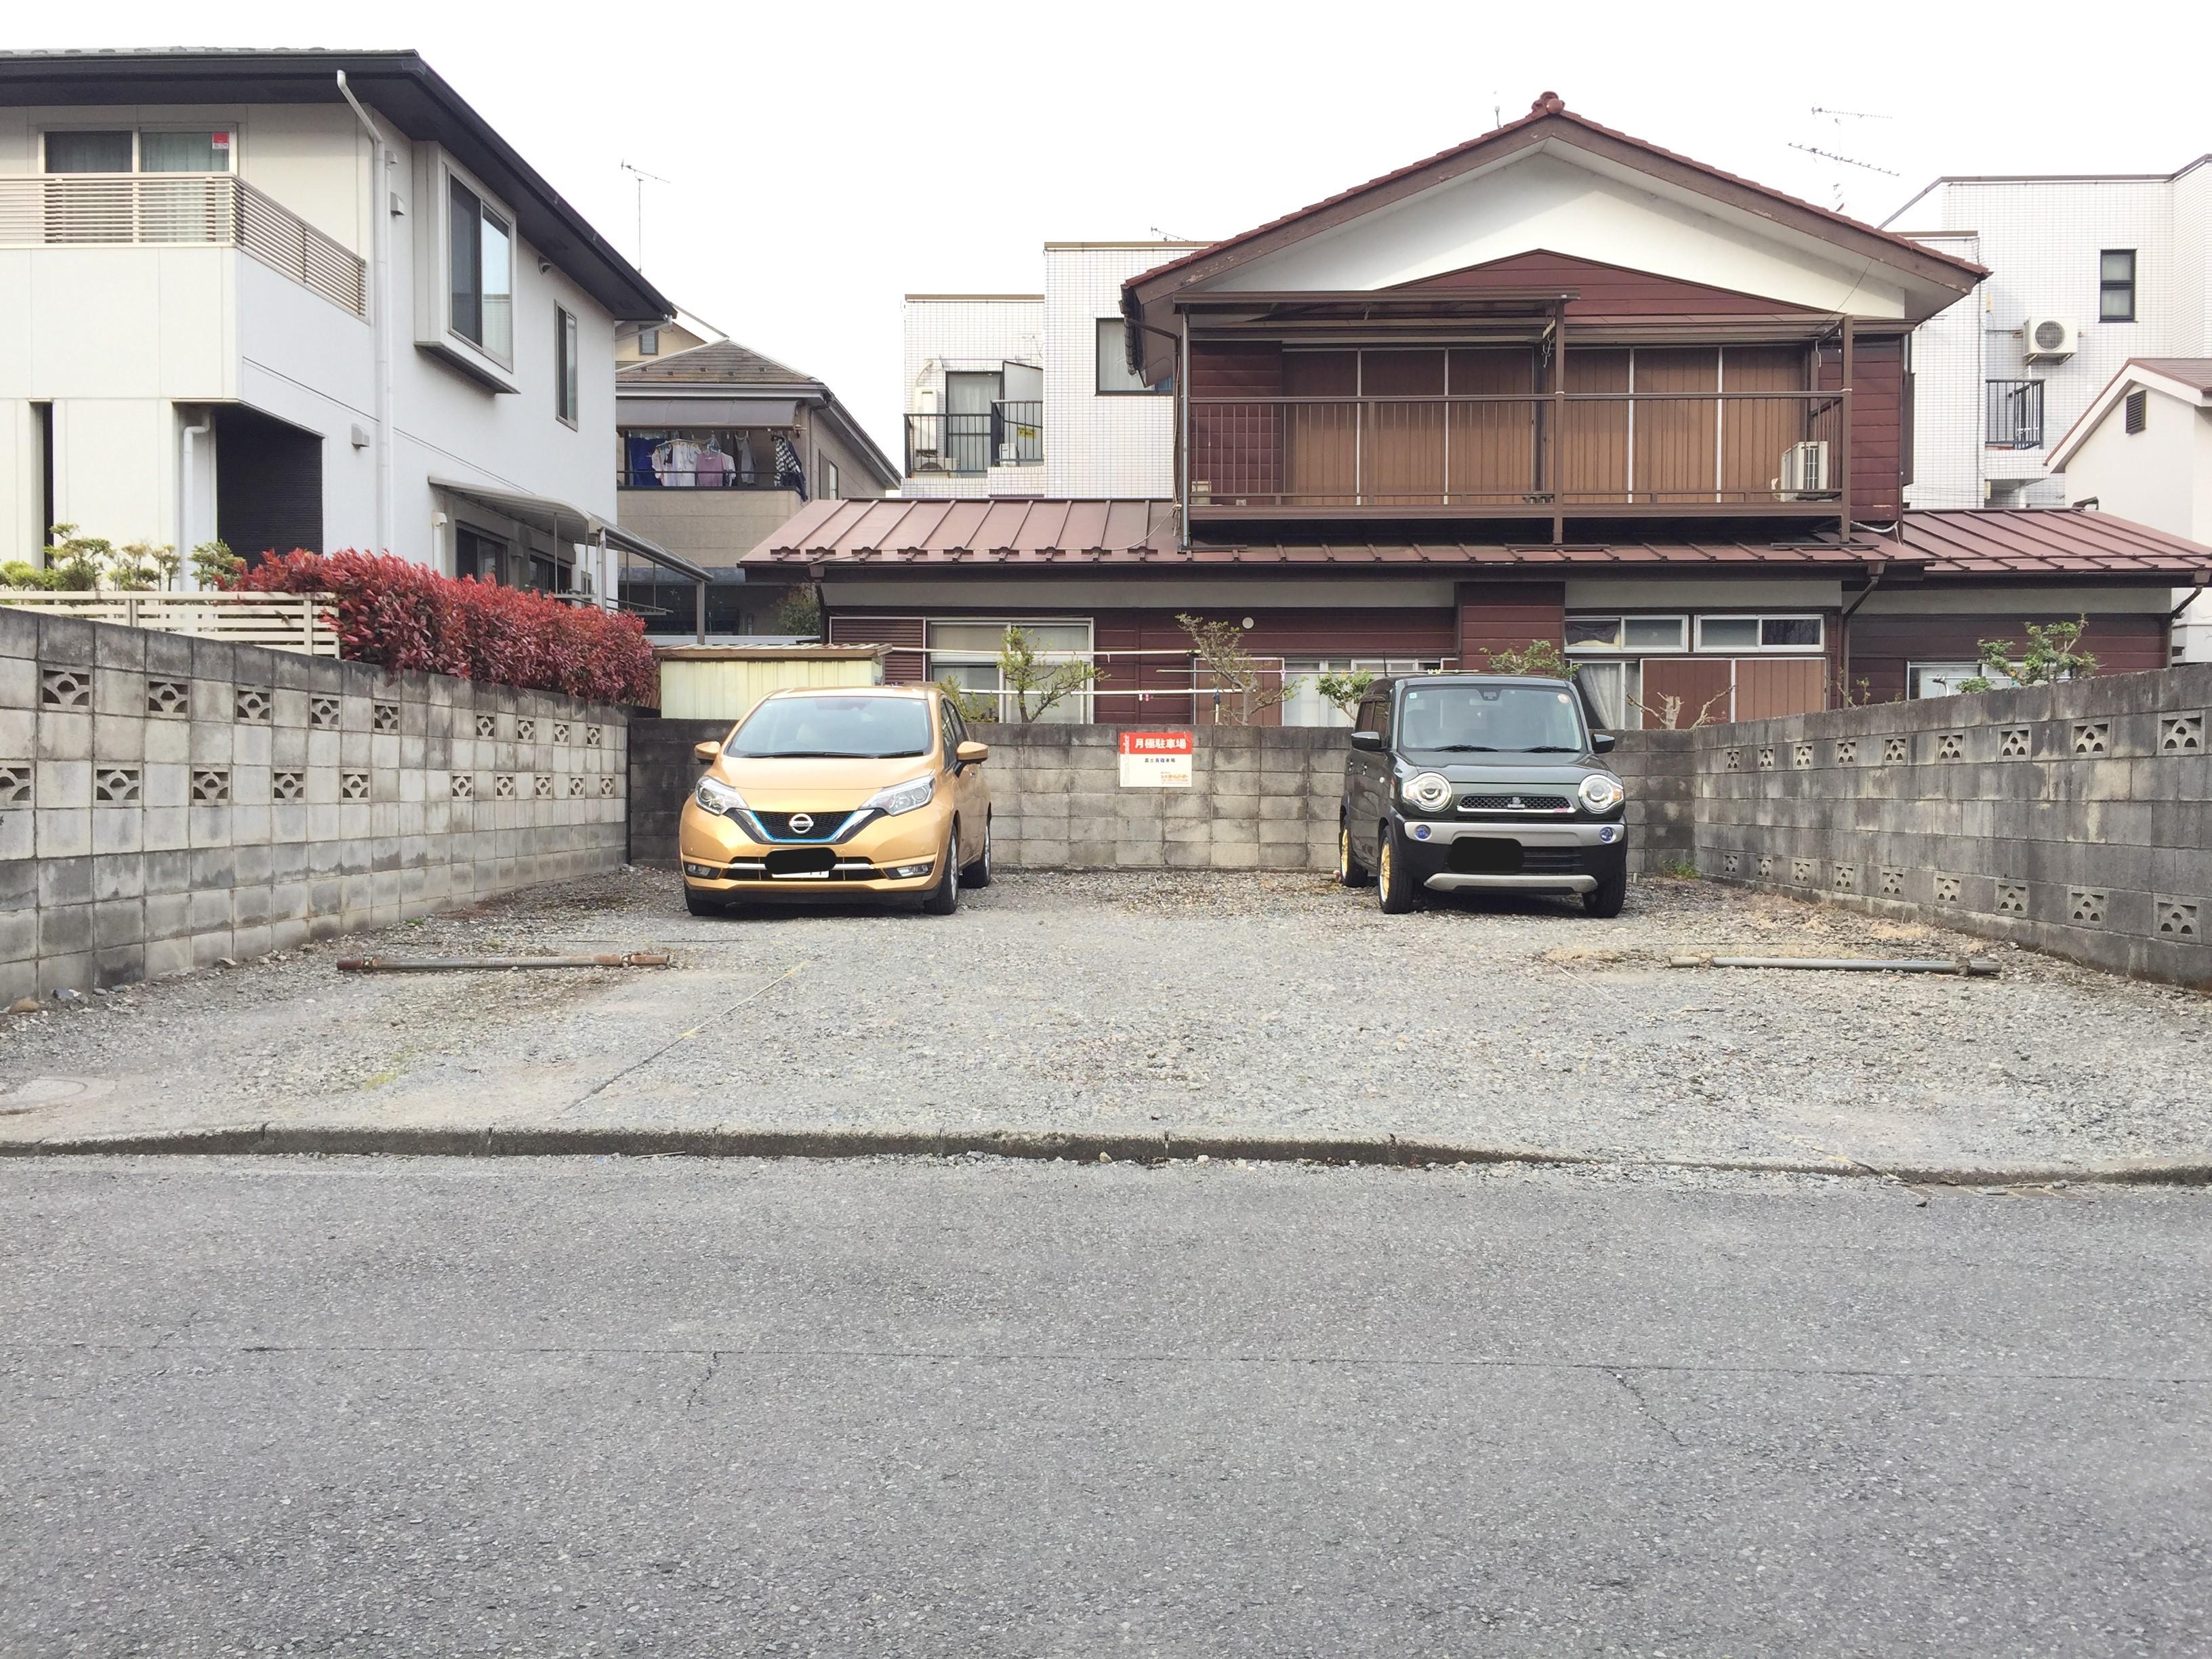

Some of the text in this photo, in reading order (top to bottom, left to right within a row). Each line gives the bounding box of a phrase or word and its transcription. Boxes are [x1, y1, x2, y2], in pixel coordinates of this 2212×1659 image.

[1135, 738, 1187, 749] 月極駐車場
